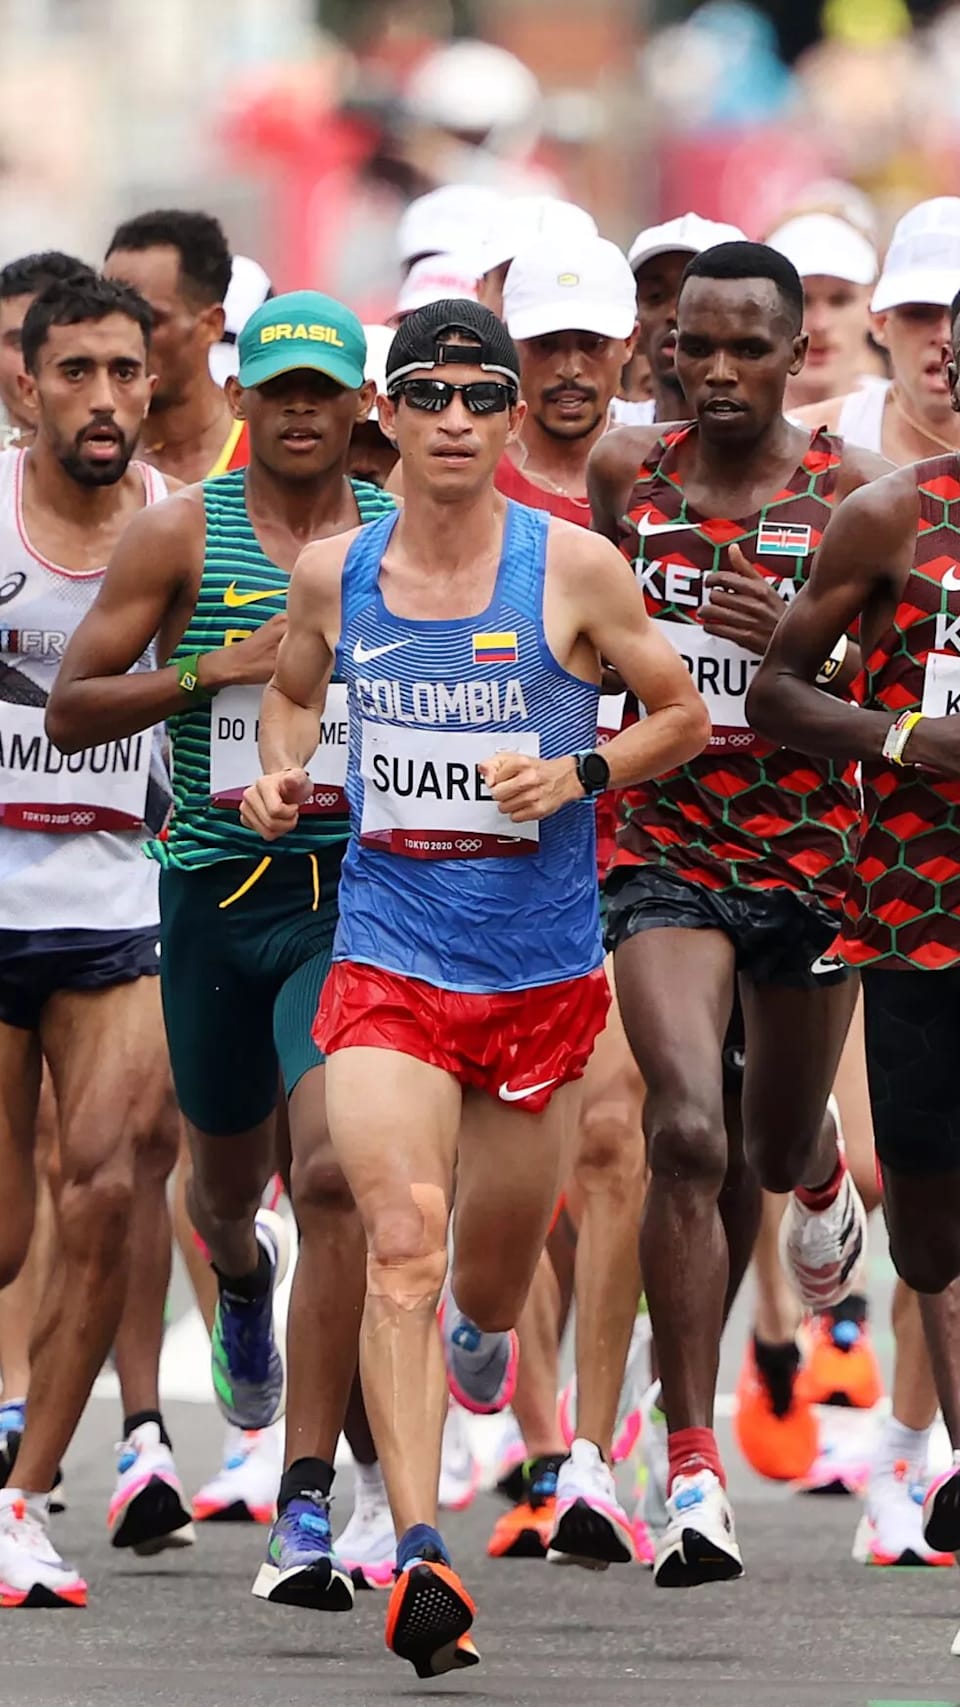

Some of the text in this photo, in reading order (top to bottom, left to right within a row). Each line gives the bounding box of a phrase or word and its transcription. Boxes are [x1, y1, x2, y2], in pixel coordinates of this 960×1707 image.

[261, 323, 345, 348] BRASIL
[634, 557, 800, 607] KEA
[355, 678, 529, 724] COLOMBIA
[218, 717, 245, 741] DO
[22, 811, 51, 823] TOKYO
[404, 838, 453, 850] TOKYO 2020
